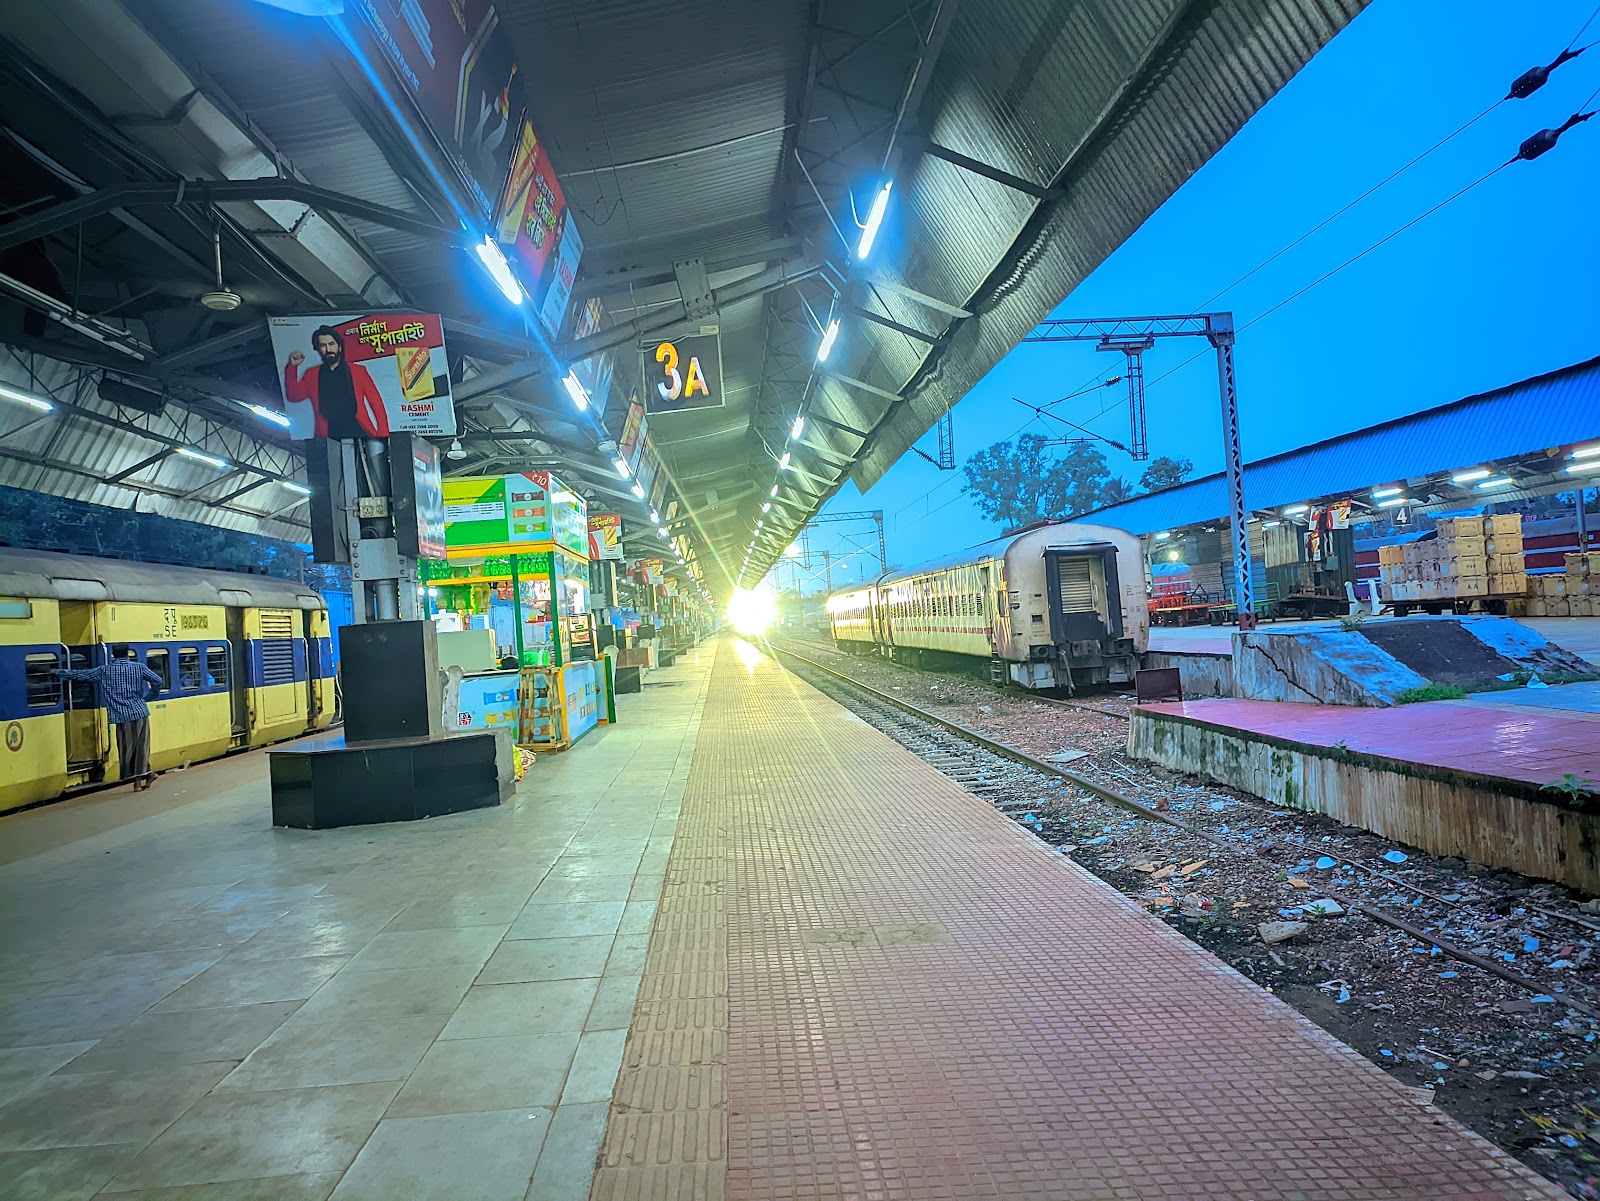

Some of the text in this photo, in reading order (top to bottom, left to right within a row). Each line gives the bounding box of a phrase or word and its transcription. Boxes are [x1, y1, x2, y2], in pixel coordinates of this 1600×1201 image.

[359, 320, 387, 337] নির্মাণ
[369, 321, 425, 353] সুপারহিট
[1396, 507, 1407, 523] 4
